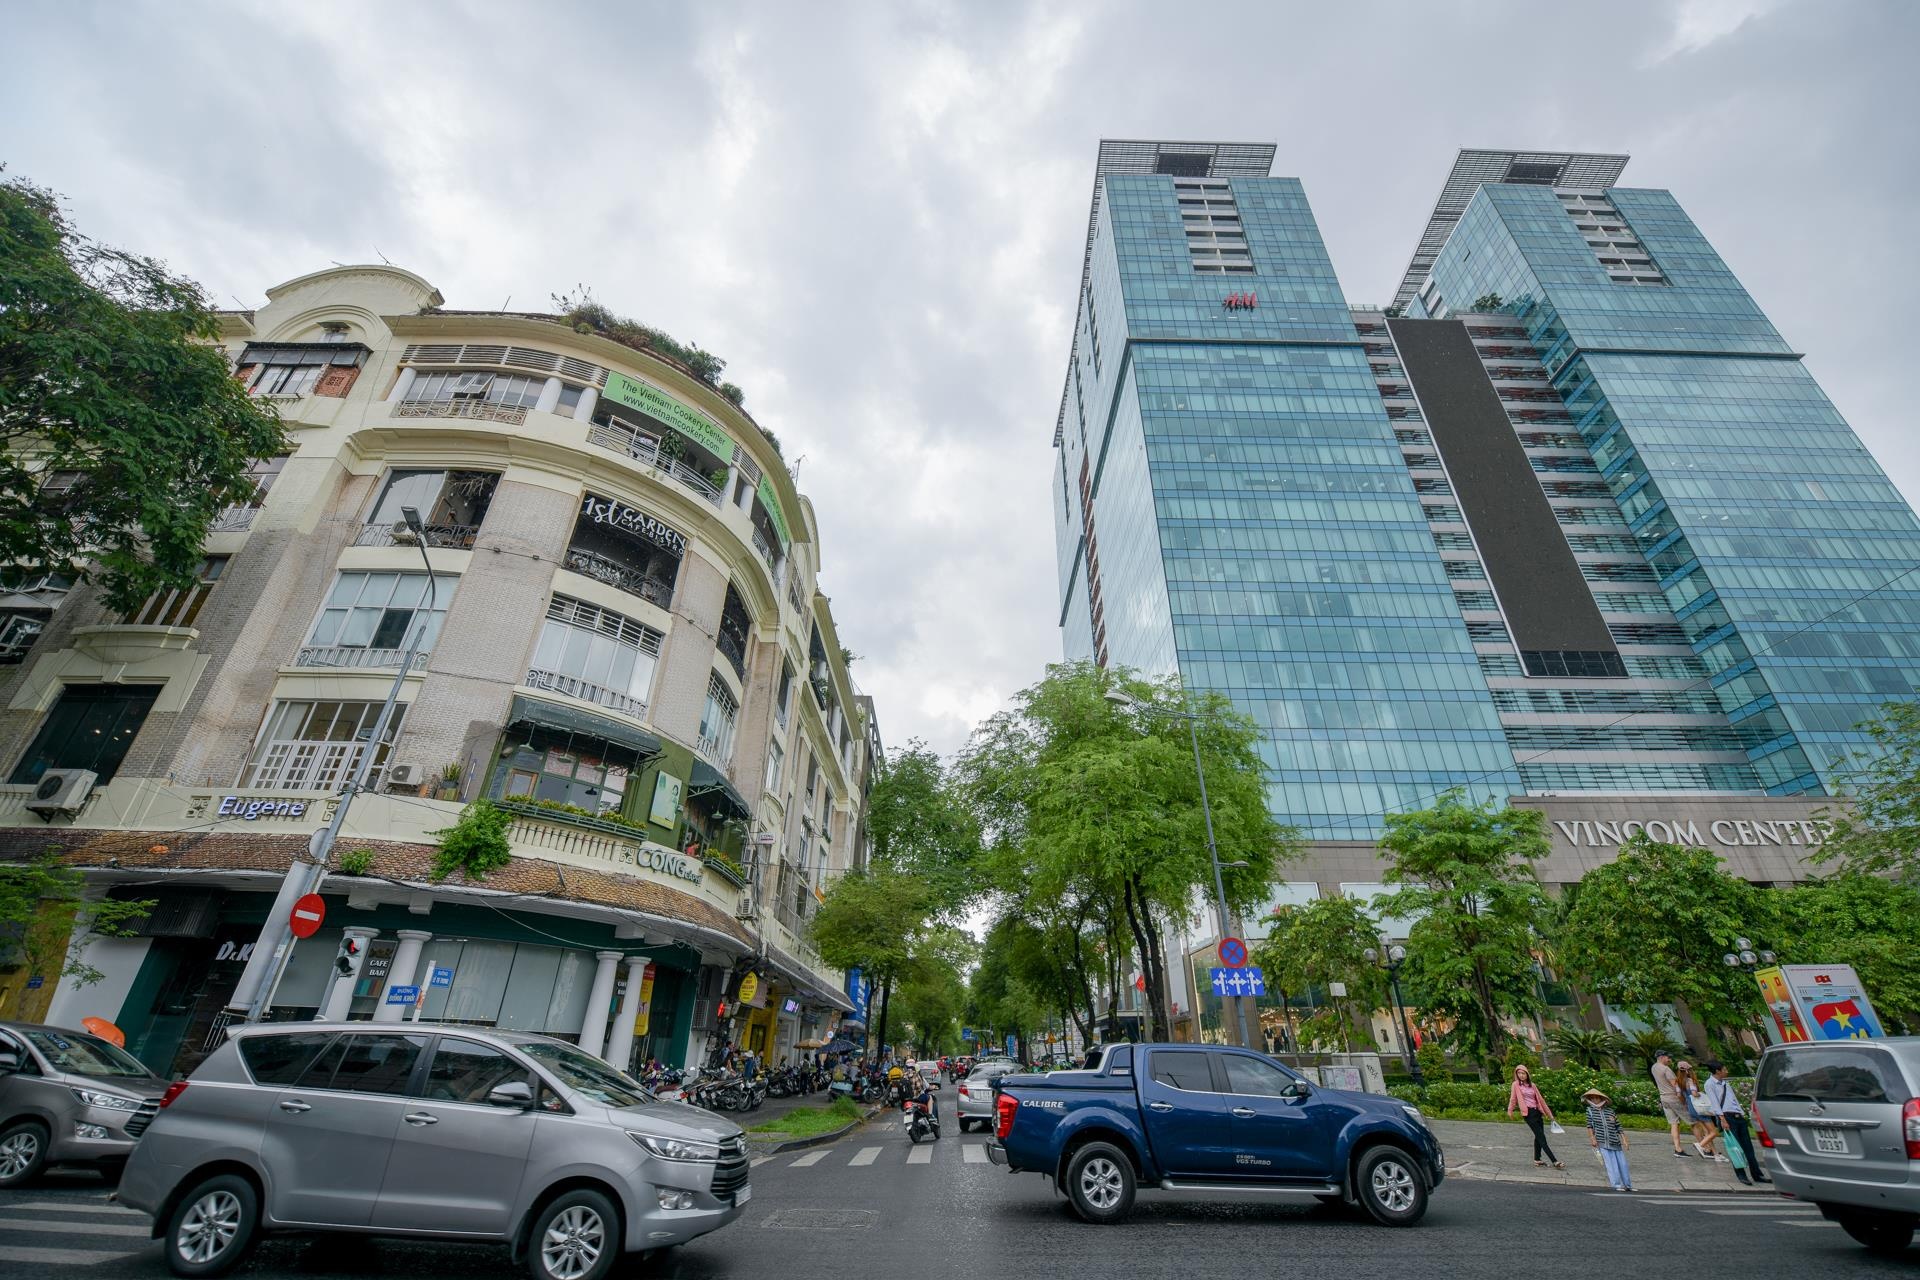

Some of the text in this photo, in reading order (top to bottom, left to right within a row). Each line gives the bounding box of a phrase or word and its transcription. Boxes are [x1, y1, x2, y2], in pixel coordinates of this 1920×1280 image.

[622, 380, 726, 446] The Vietnam Cookery Center
[623, 393, 720, 453] www.vietnamcookery.com
[584, 497, 687, 550] 1st GARDEN
[218, 796, 305, 820] Eugene
[1554, 819, 1708, 847] VINCOM
[368, 969, 386, 977] BAR
[369, 959, 389, 968] CAFE
[1022, 1100, 1065, 1109] CALIBRE
